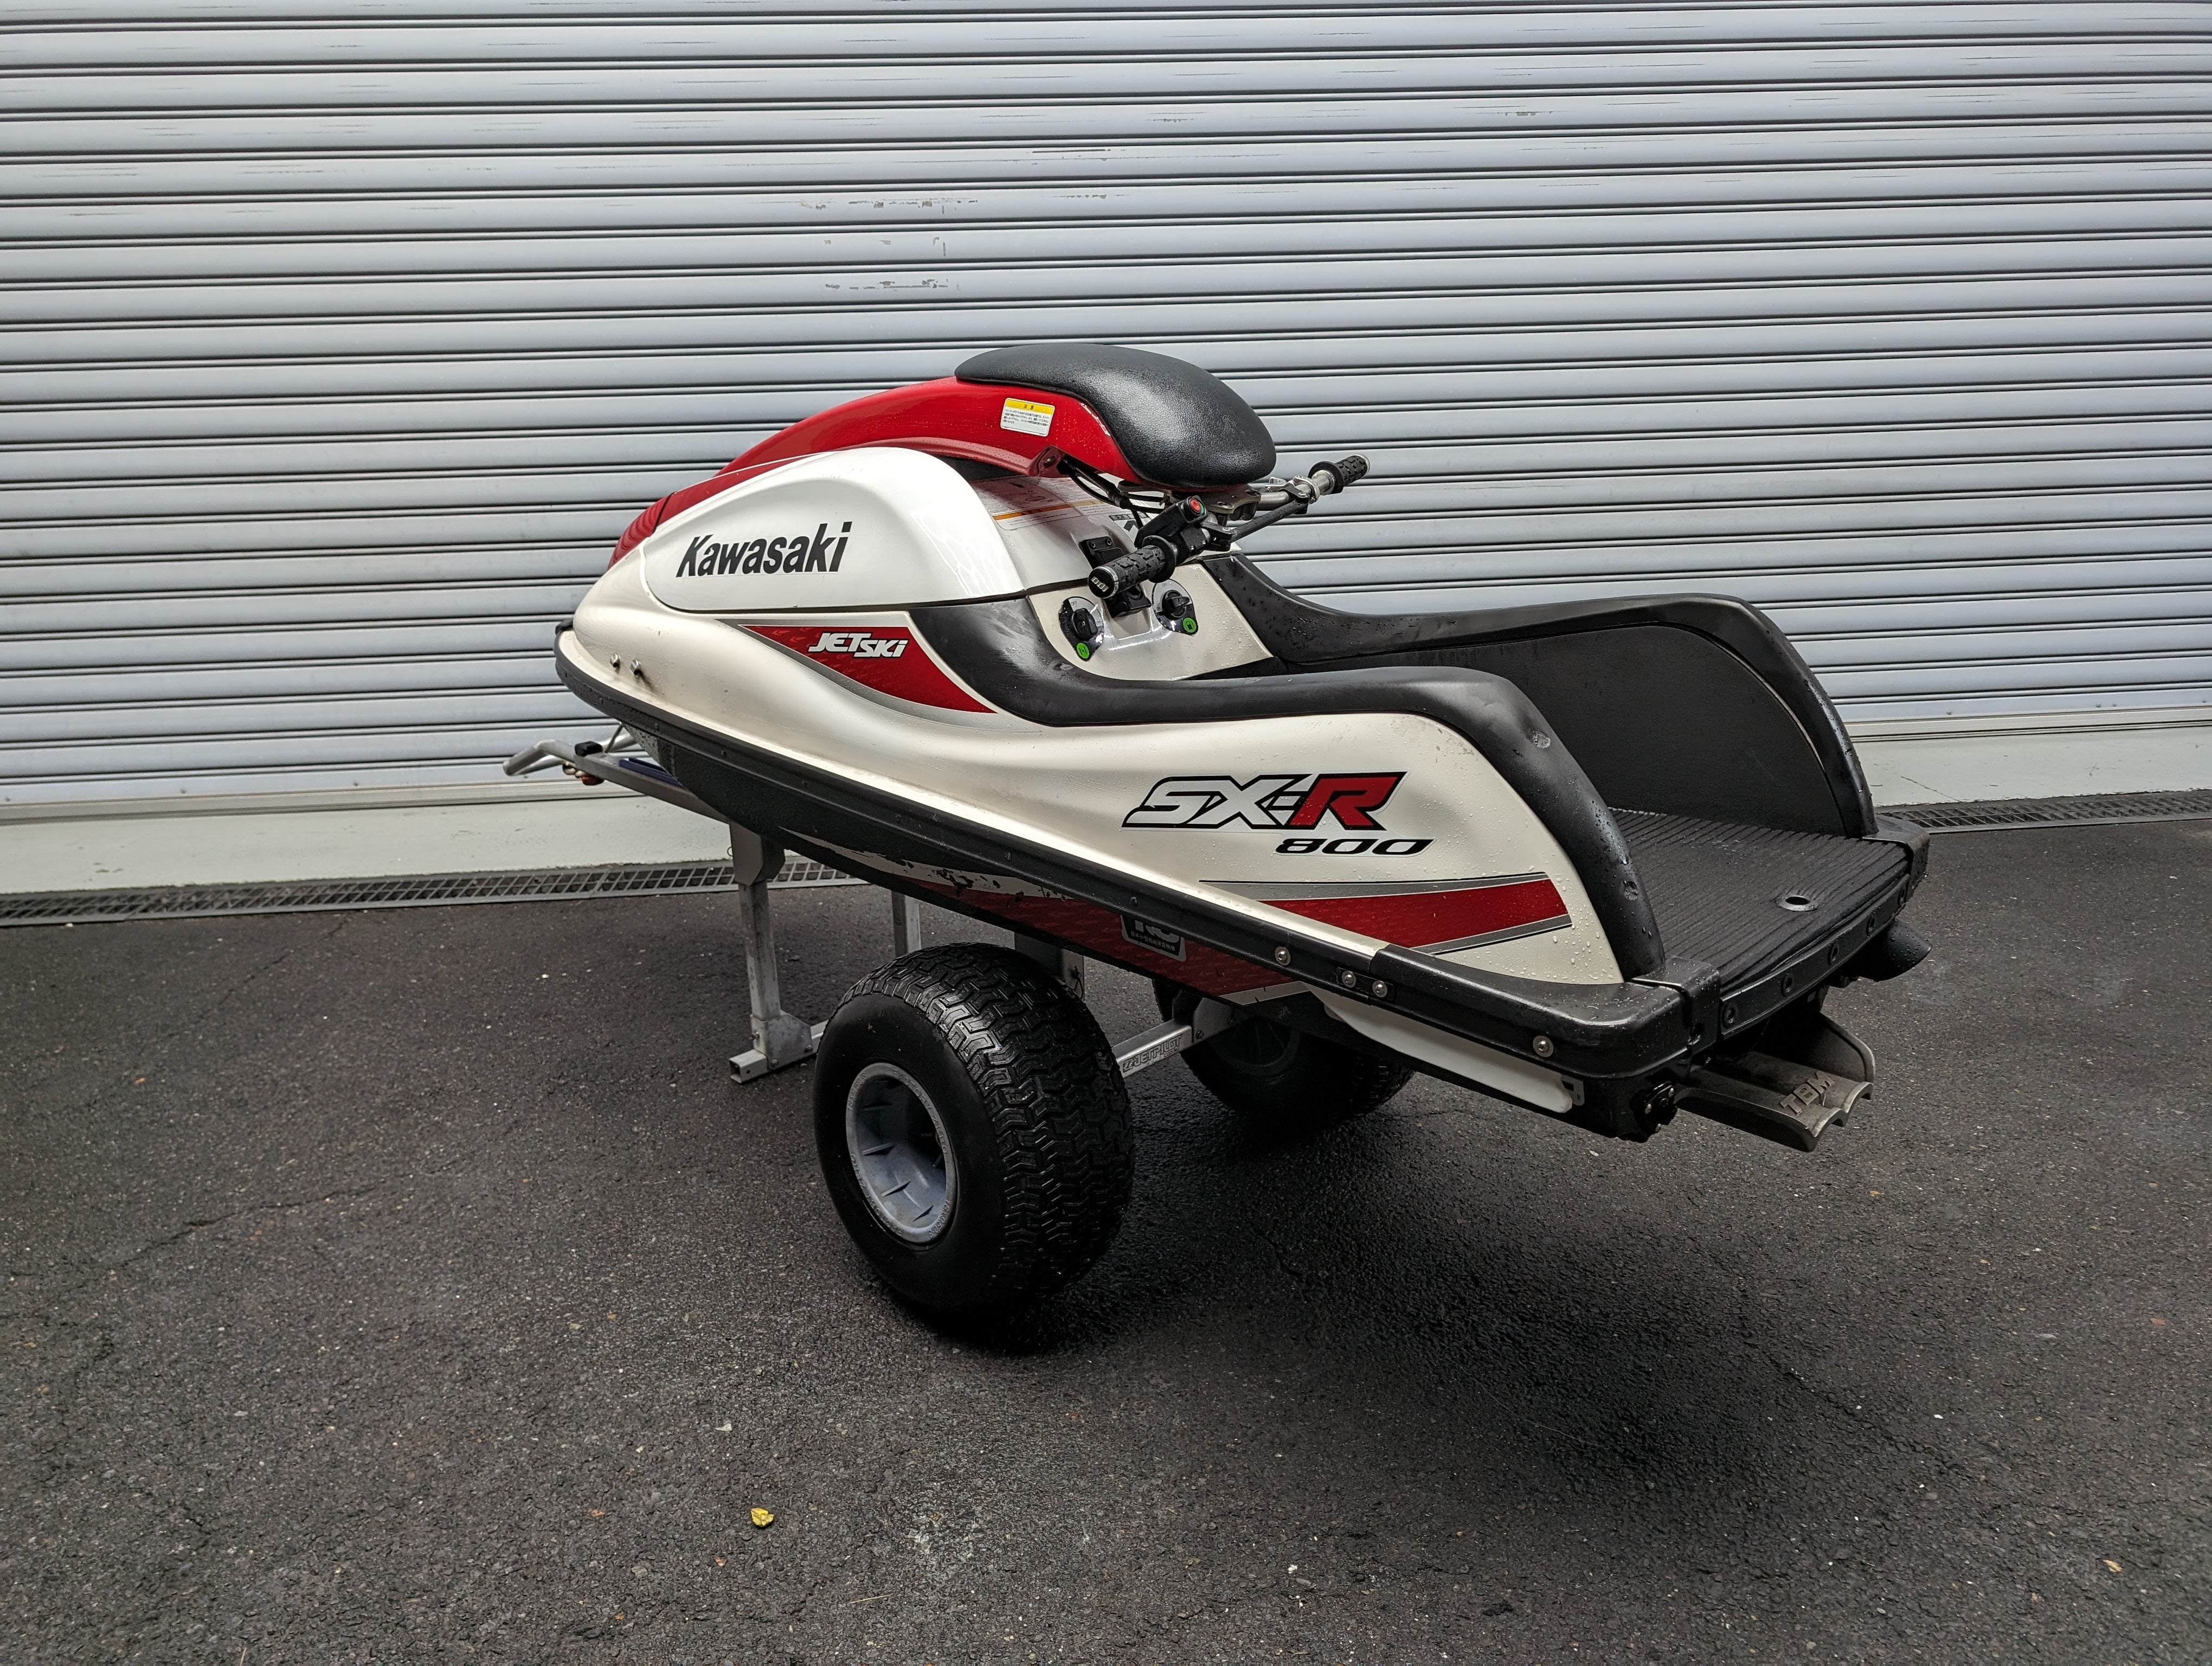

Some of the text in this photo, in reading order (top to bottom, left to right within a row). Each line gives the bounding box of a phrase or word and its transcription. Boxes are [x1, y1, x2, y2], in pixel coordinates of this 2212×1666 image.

[676, 521, 852, 578] Kawasaki
[1276, 838, 1435, 854] 800
[1780, 1071, 1835, 1116] TBM
